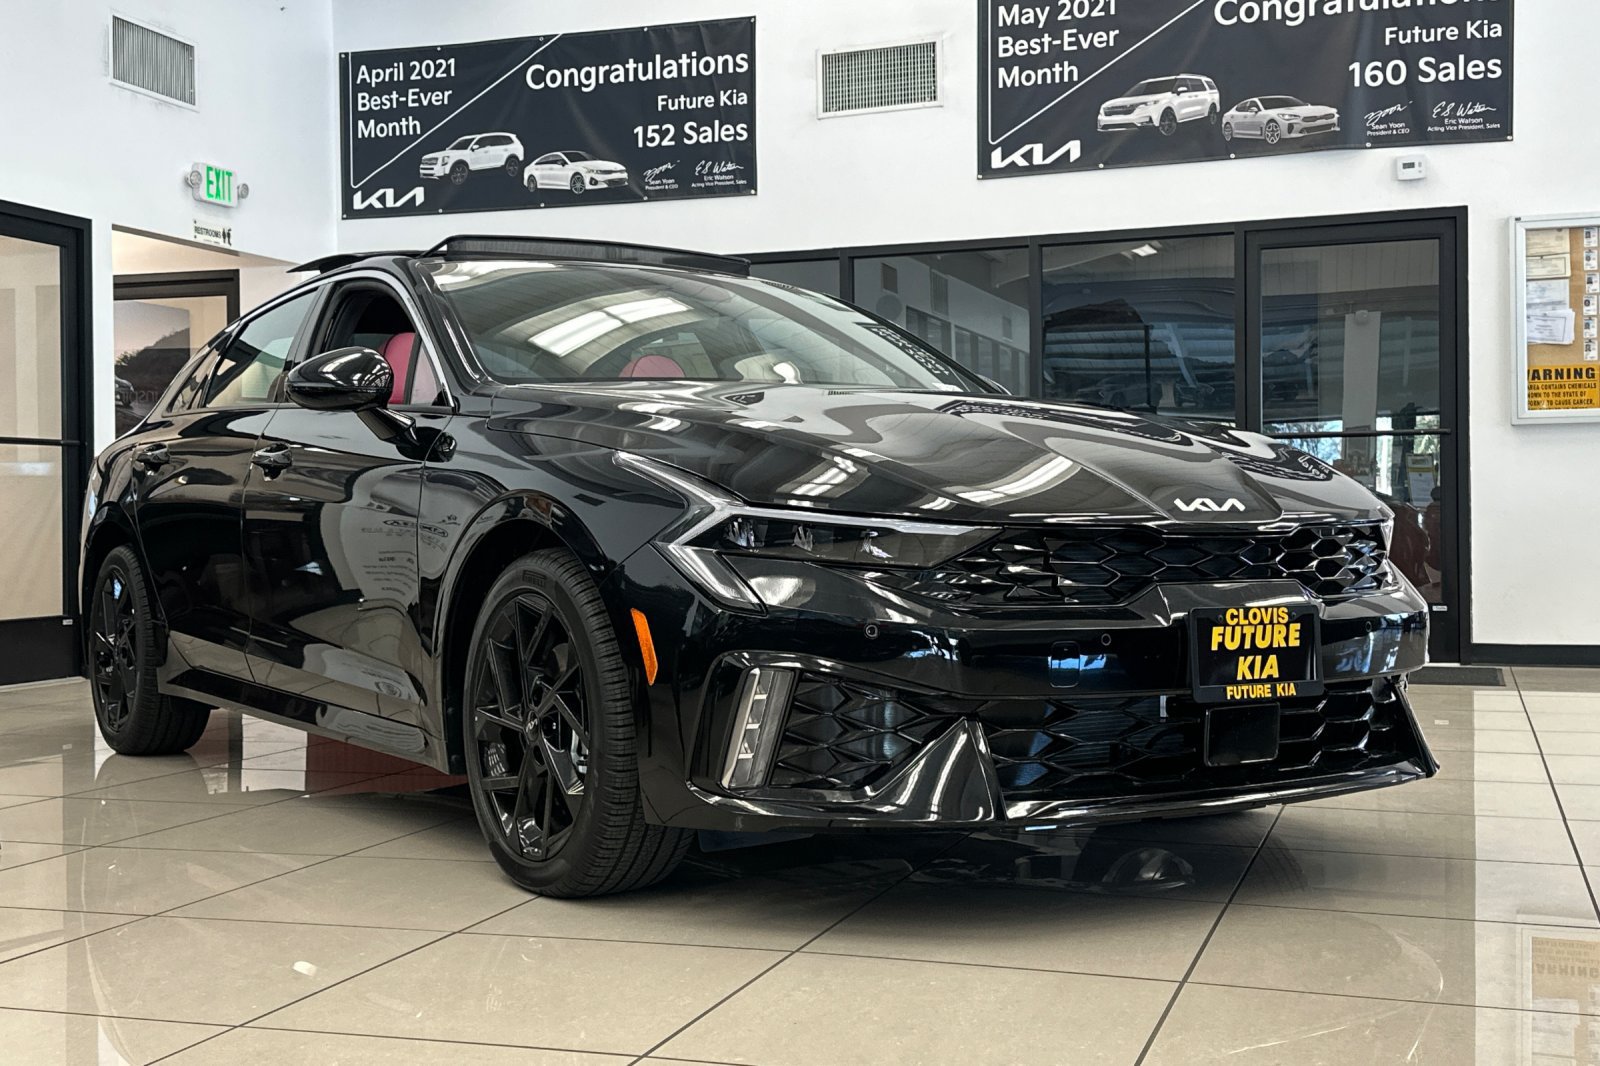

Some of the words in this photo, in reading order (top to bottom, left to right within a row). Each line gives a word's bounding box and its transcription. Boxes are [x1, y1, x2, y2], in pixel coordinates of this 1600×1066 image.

[998, 4, 1050, 28] May
[1057, 0, 1116, 20] 2021
[998, 29, 1120, 58] Best-Ever
[1385, 24, 1459, 46] Future
[1466, 20, 1503, 38] Kia
[356, 62, 404, 87] April
[409, 58, 456, 80] 2021
[525, 51, 749, 92] Congratulations
[998, 60, 1079, 89] Month
[1348, 60, 1407, 87] 160
[1418, 54, 1503, 83] Sales
[357, 88, 452, 112] Best-Ever
[657, 94, 715, 112] Future
[720, 89, 748, 107] Kia
[357, 116, 422, 139] Month
[1397, 127, 1410, 135] CEO
[1427, 125, 1445, 133] Acting
[1445, 124, 1458, 132] Vice
[1458, 117, 1484, 125] Watson
[633, 124, 676, 148] 152
[683, 119, 748, 145] Sales
[991, 140, 1081, 169] KIA
[206, 165, 233, 203] EXIT
[353, 187, 425, 210] KIA
[194, 225, 221, 239] RESTROOMS
[1528, 367, 1595, 380] ARNING
[1562, 390, 1579, 398] STATE
[1579, 390, 1587, 398] OF
[1567, 382, 1597, 390] CHEMICALS
[1174, 498, 1246, 512] KIA
[1225, 606, 1289, 626] CLOVIS
[1211, 622, 1301, 651] FUTURE
[1236, 654, 1280, 681] KIA
[1226, 684, 1272, 700] FUTURE
[1276, 682, 1297, 697] KIA
